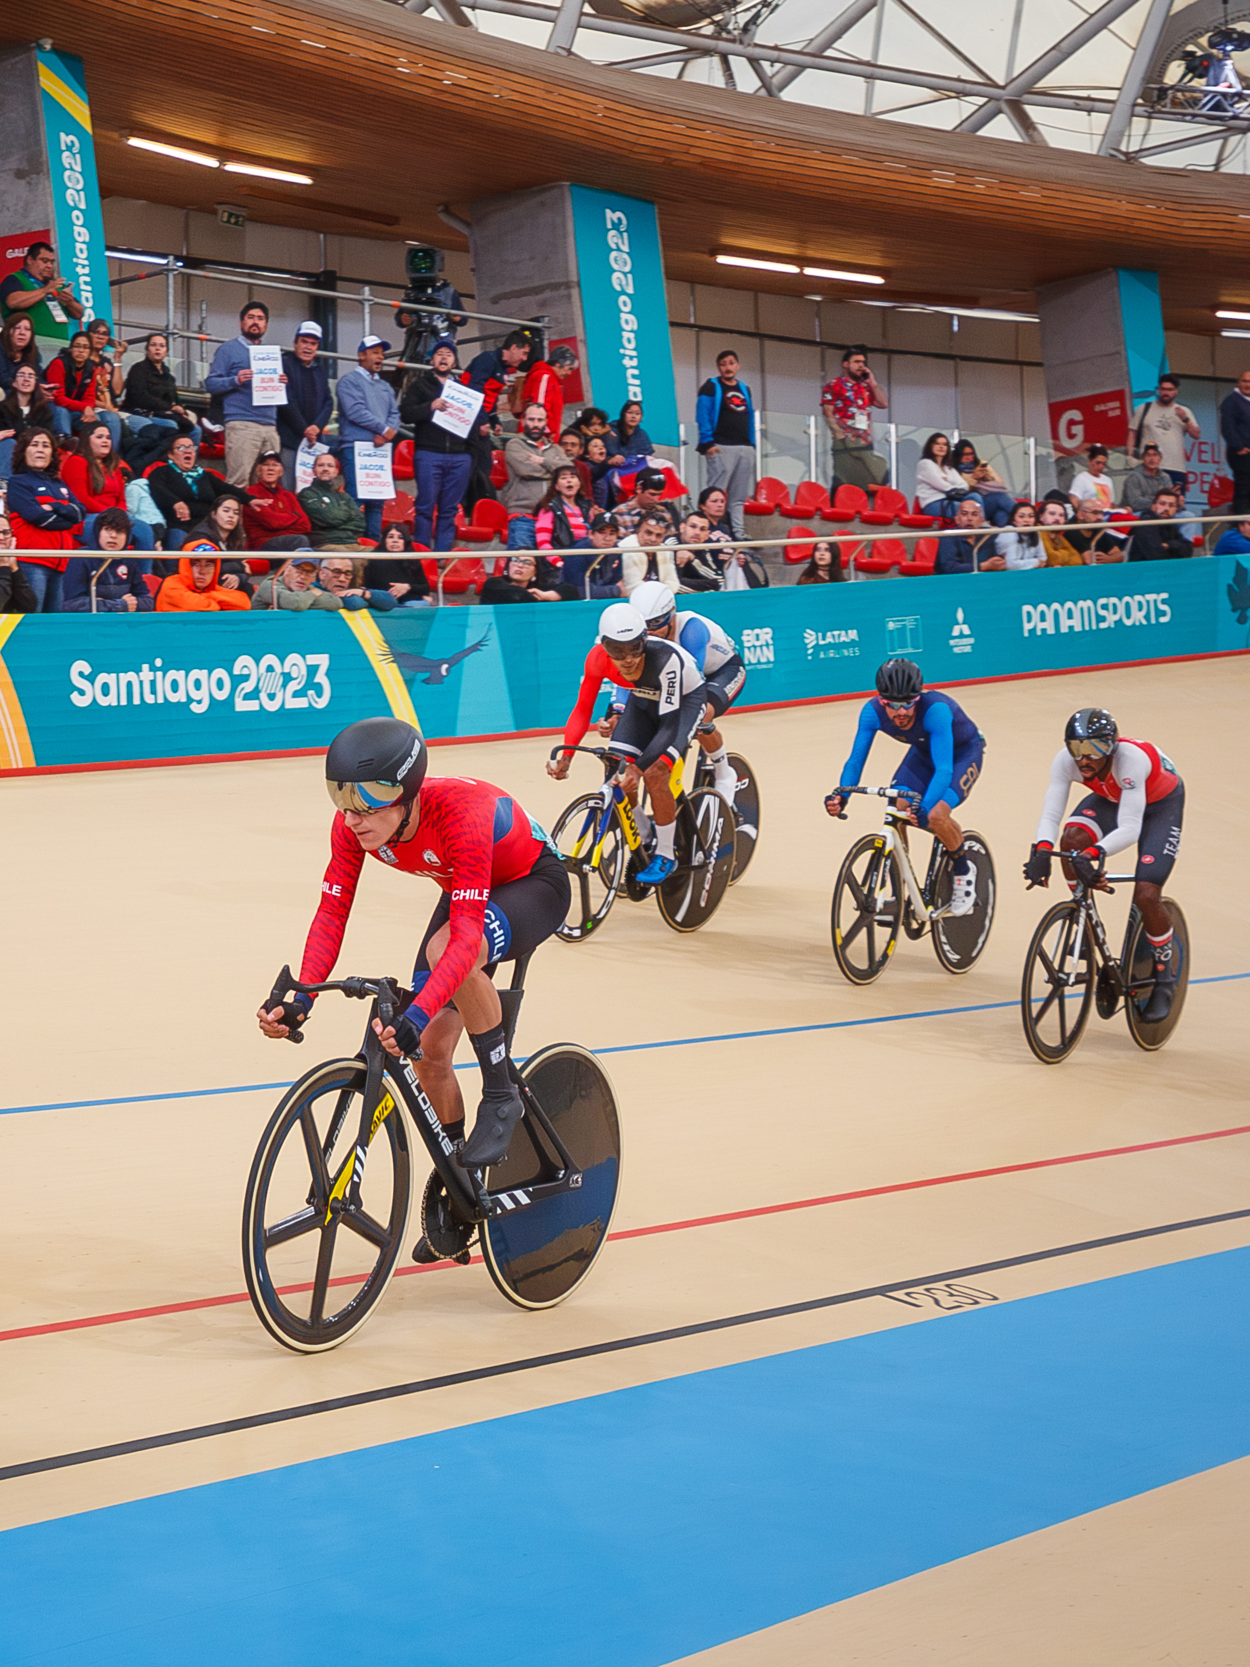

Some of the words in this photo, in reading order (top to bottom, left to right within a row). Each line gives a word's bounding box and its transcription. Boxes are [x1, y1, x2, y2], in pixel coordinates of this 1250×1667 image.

[60, 132, 87, 209] 2023
[605, 208, 635, 295] 2023
[618, 295, 643, 402] antiago
[443, 410, 472, 426] ONTIGO
[1058, 409, 1085, 449] G
[1022, 592, 1172, 638] PANAMSPORTS
[742, 627, 774, 647] BOR
[743, 645, 776, 665] NAN
[817, 630, 860, 645] LATAM
[819, 647, 861, 659] AIRLINES
[69, 657, 232, 714] Santiago
[233, 653, 332, 712] 2023
[622, 802, 640, 845] LOOK
[1162, 825, 1182, 857] TEAM
[451, 888, 490, 901] CHILE
[370, 1097, 392, 1133] AVIC
[399, 1055, 454, 1157] VELOBIKE
[903, 1283, 1000, 1311] 230
